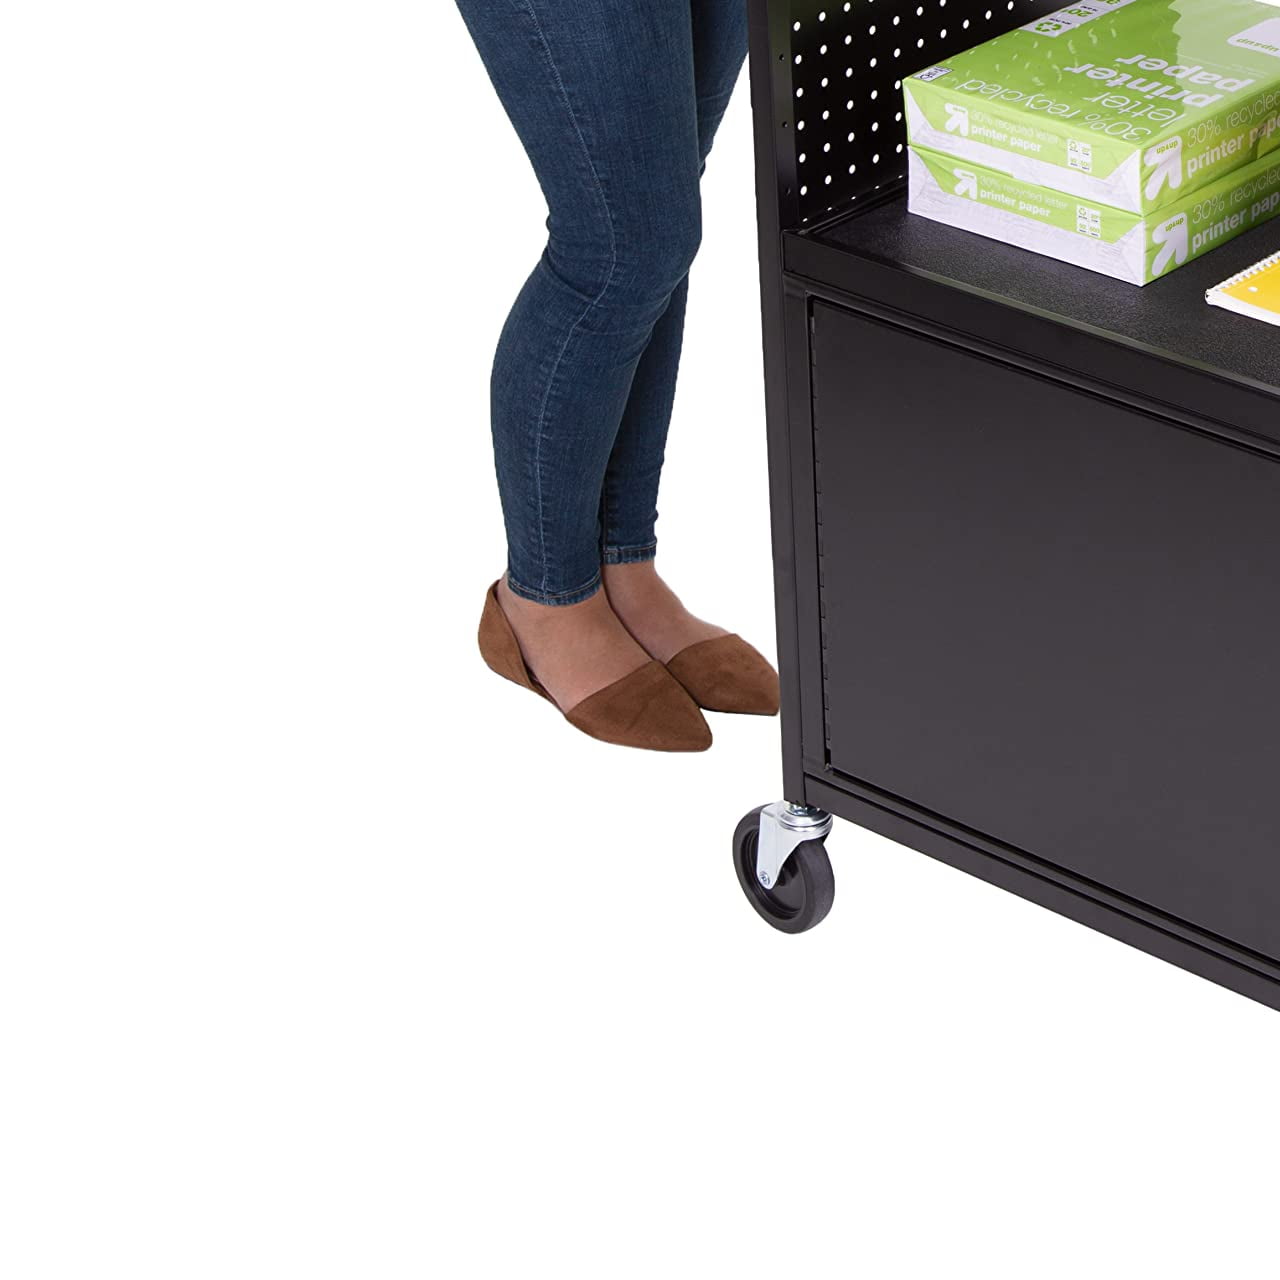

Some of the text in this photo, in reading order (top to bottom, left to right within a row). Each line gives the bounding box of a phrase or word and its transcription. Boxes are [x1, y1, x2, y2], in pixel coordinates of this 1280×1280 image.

[1064, 63, 1225, 108] printer
[1115, 54, 1256, 92] paper
[955, 79, 1152, 141] 30% recycled
[1083, 91, 1187, 128] letter
[971, 126, 1042, 152] printer paper
[1156, 140, 1178, 154] up&up
[1187, 115, 1222, 148] 30%
[1186, 134, 1245, 179] printer
[980, 189, 1051, 217] printer paper
[1192, 193, 1226, 224] 30%
[1191, 209, 1247, 254] printer
